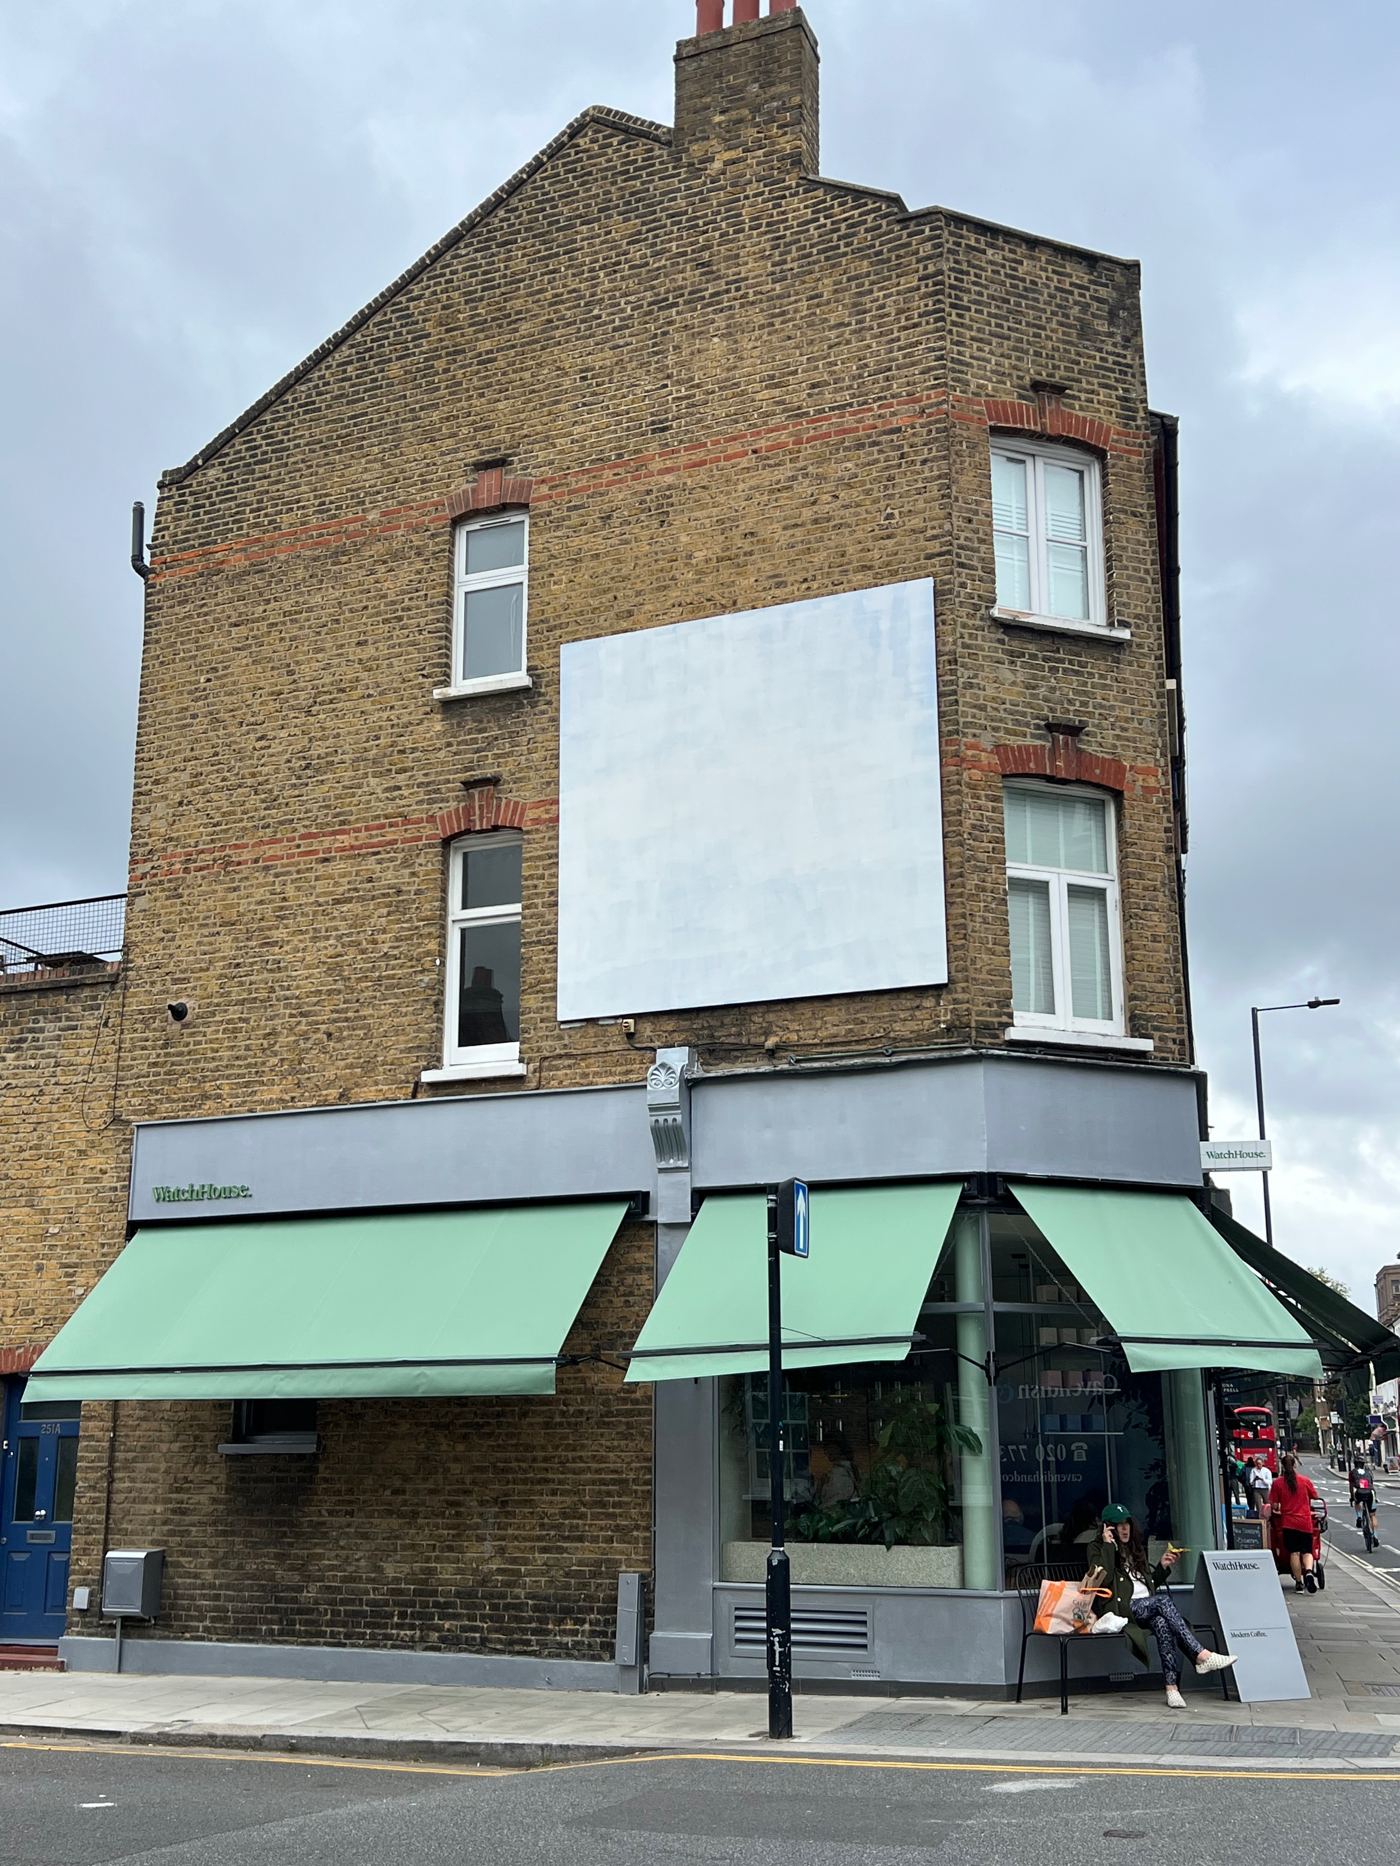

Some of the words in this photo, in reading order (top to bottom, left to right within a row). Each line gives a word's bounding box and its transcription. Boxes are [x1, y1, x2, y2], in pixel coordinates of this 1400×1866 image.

[1206, 1149, 1266, 1159] WatchHouse.
[152, 1183, 252, 1203] WatchHouse.
[40, 1423, 61, 1435] 251A
[1212, 1560, 1260, 1571] WatchHouse.
